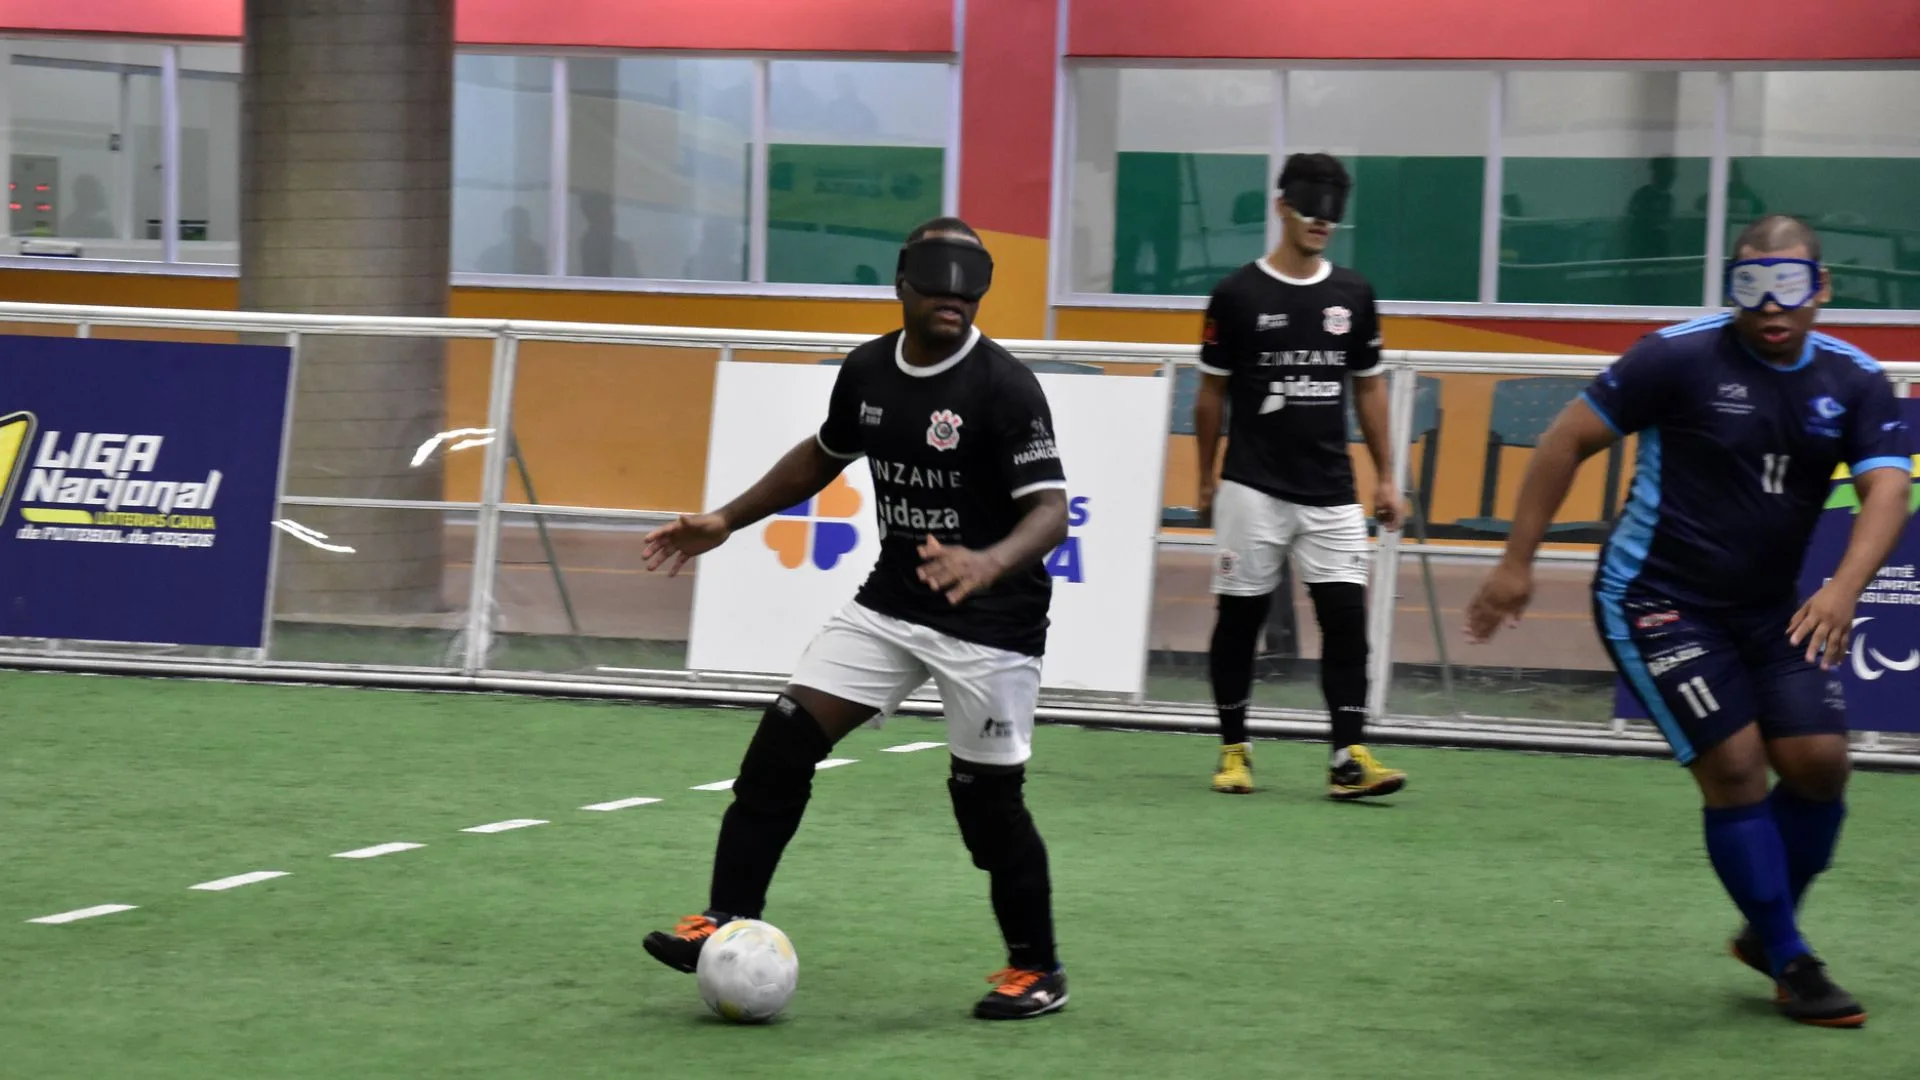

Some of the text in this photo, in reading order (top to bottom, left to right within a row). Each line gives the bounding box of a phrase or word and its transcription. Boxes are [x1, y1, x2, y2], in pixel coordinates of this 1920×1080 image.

[1257, 350, 1347, 366] ZINZANE
[33, 431, 164, 477] LIGA
[1761, 453, 1790, 494] 11
[21, 469, 223, 514] Nacional
[884, 495, 960, 529] idaza
[1876, 564, 1915, 578] MITÊ
[1677, 676, 1720, 718] 11
